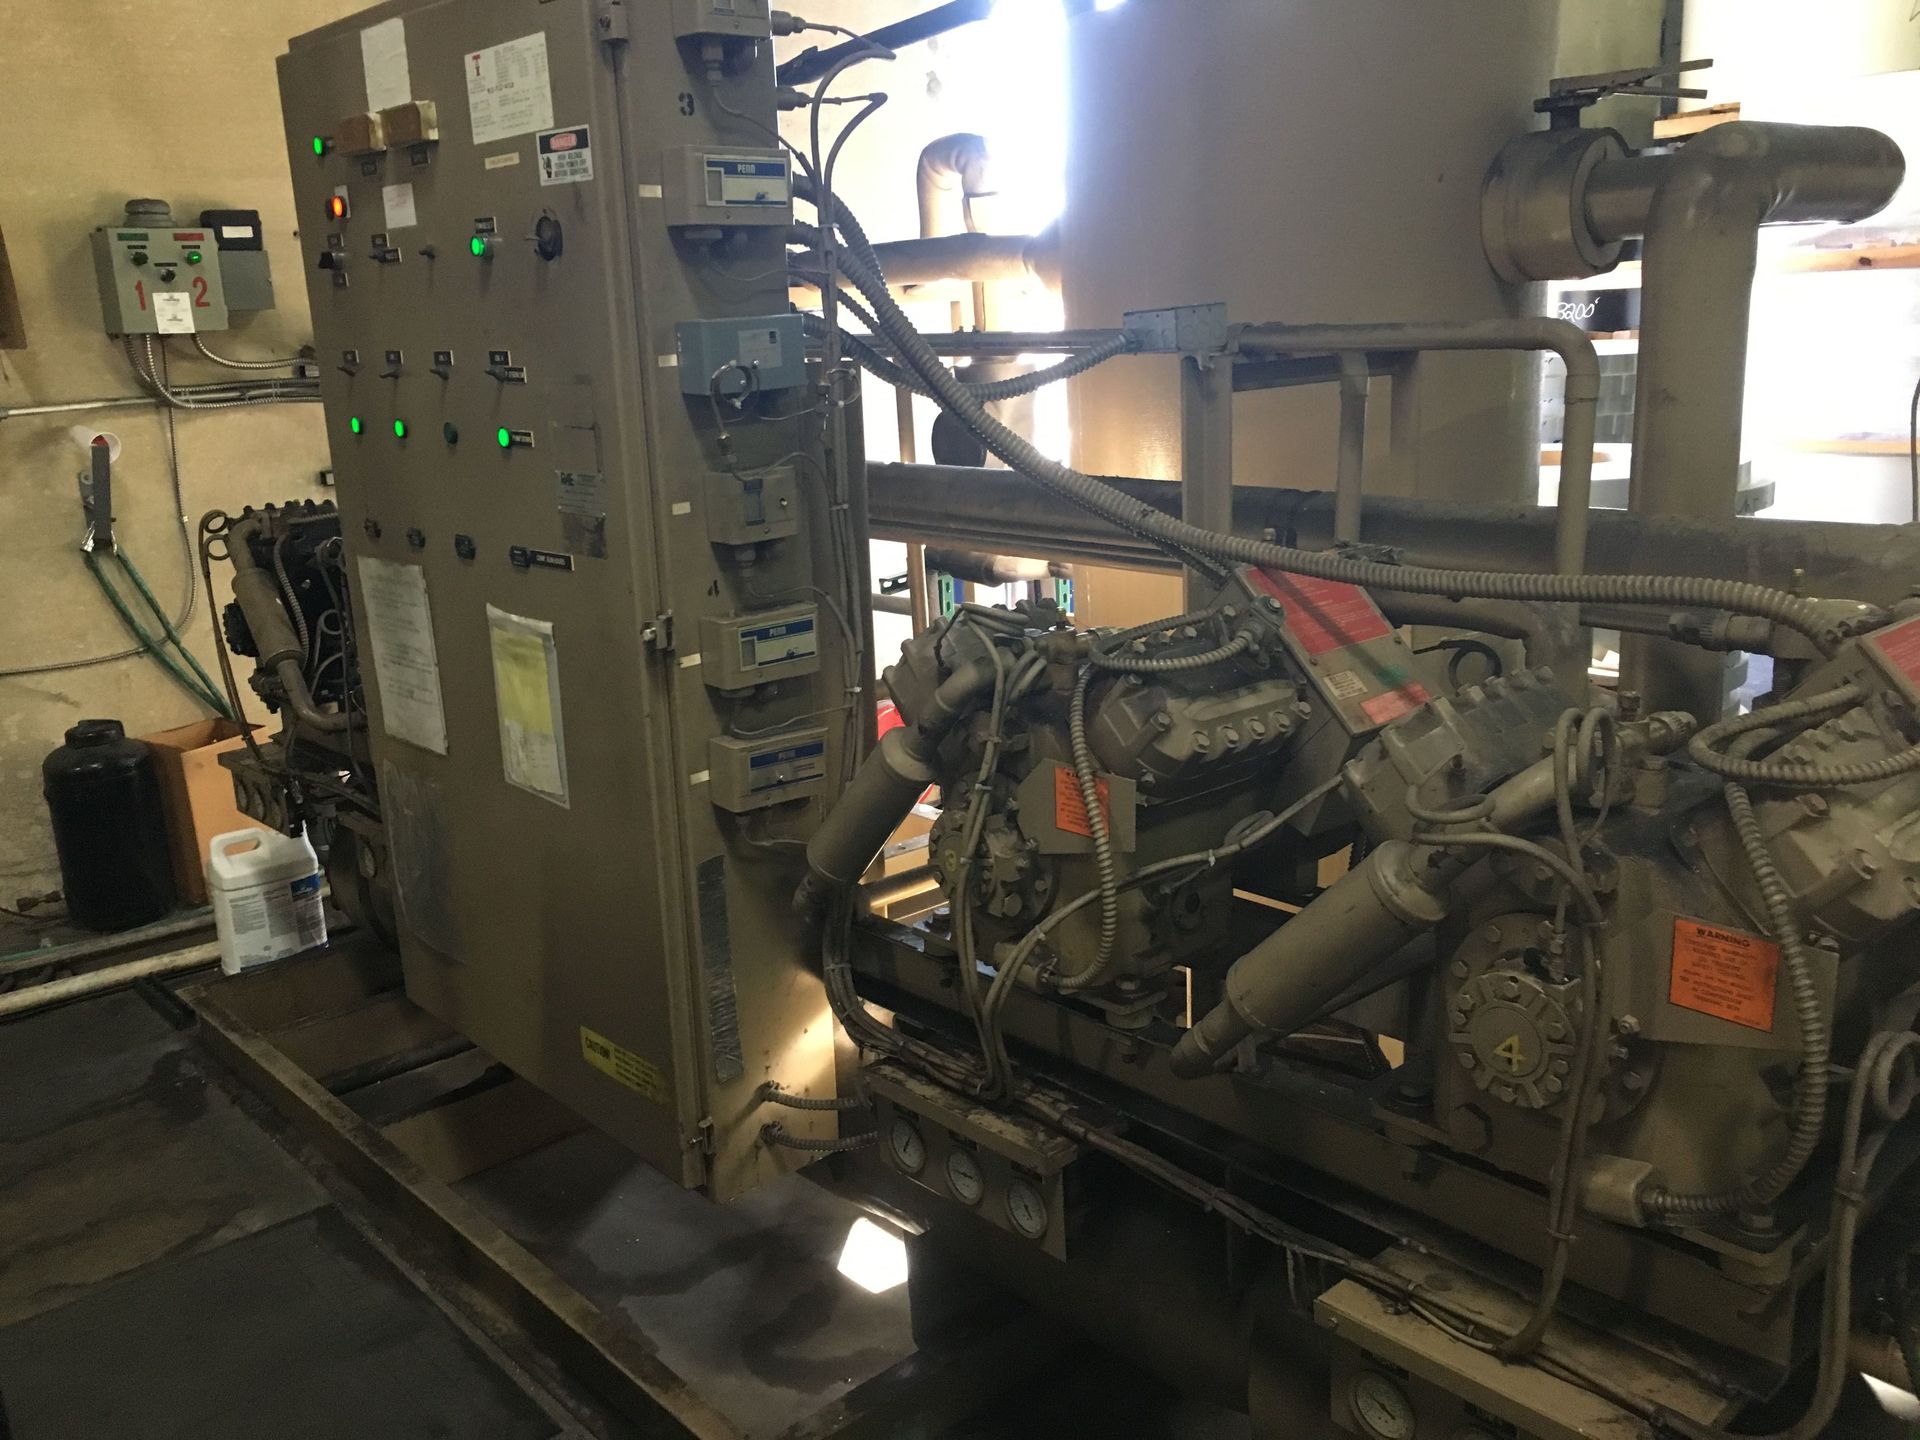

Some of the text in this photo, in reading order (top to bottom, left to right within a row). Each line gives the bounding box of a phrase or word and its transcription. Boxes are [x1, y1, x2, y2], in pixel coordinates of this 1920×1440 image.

[678, 91, 695, 117] 3
[135, 280, 146, 311] 1
[192, 276, 210, 308] 2
[1696, 927, 1750, 948] WARNING
[1494, 1034, 1527, 1072] 4
